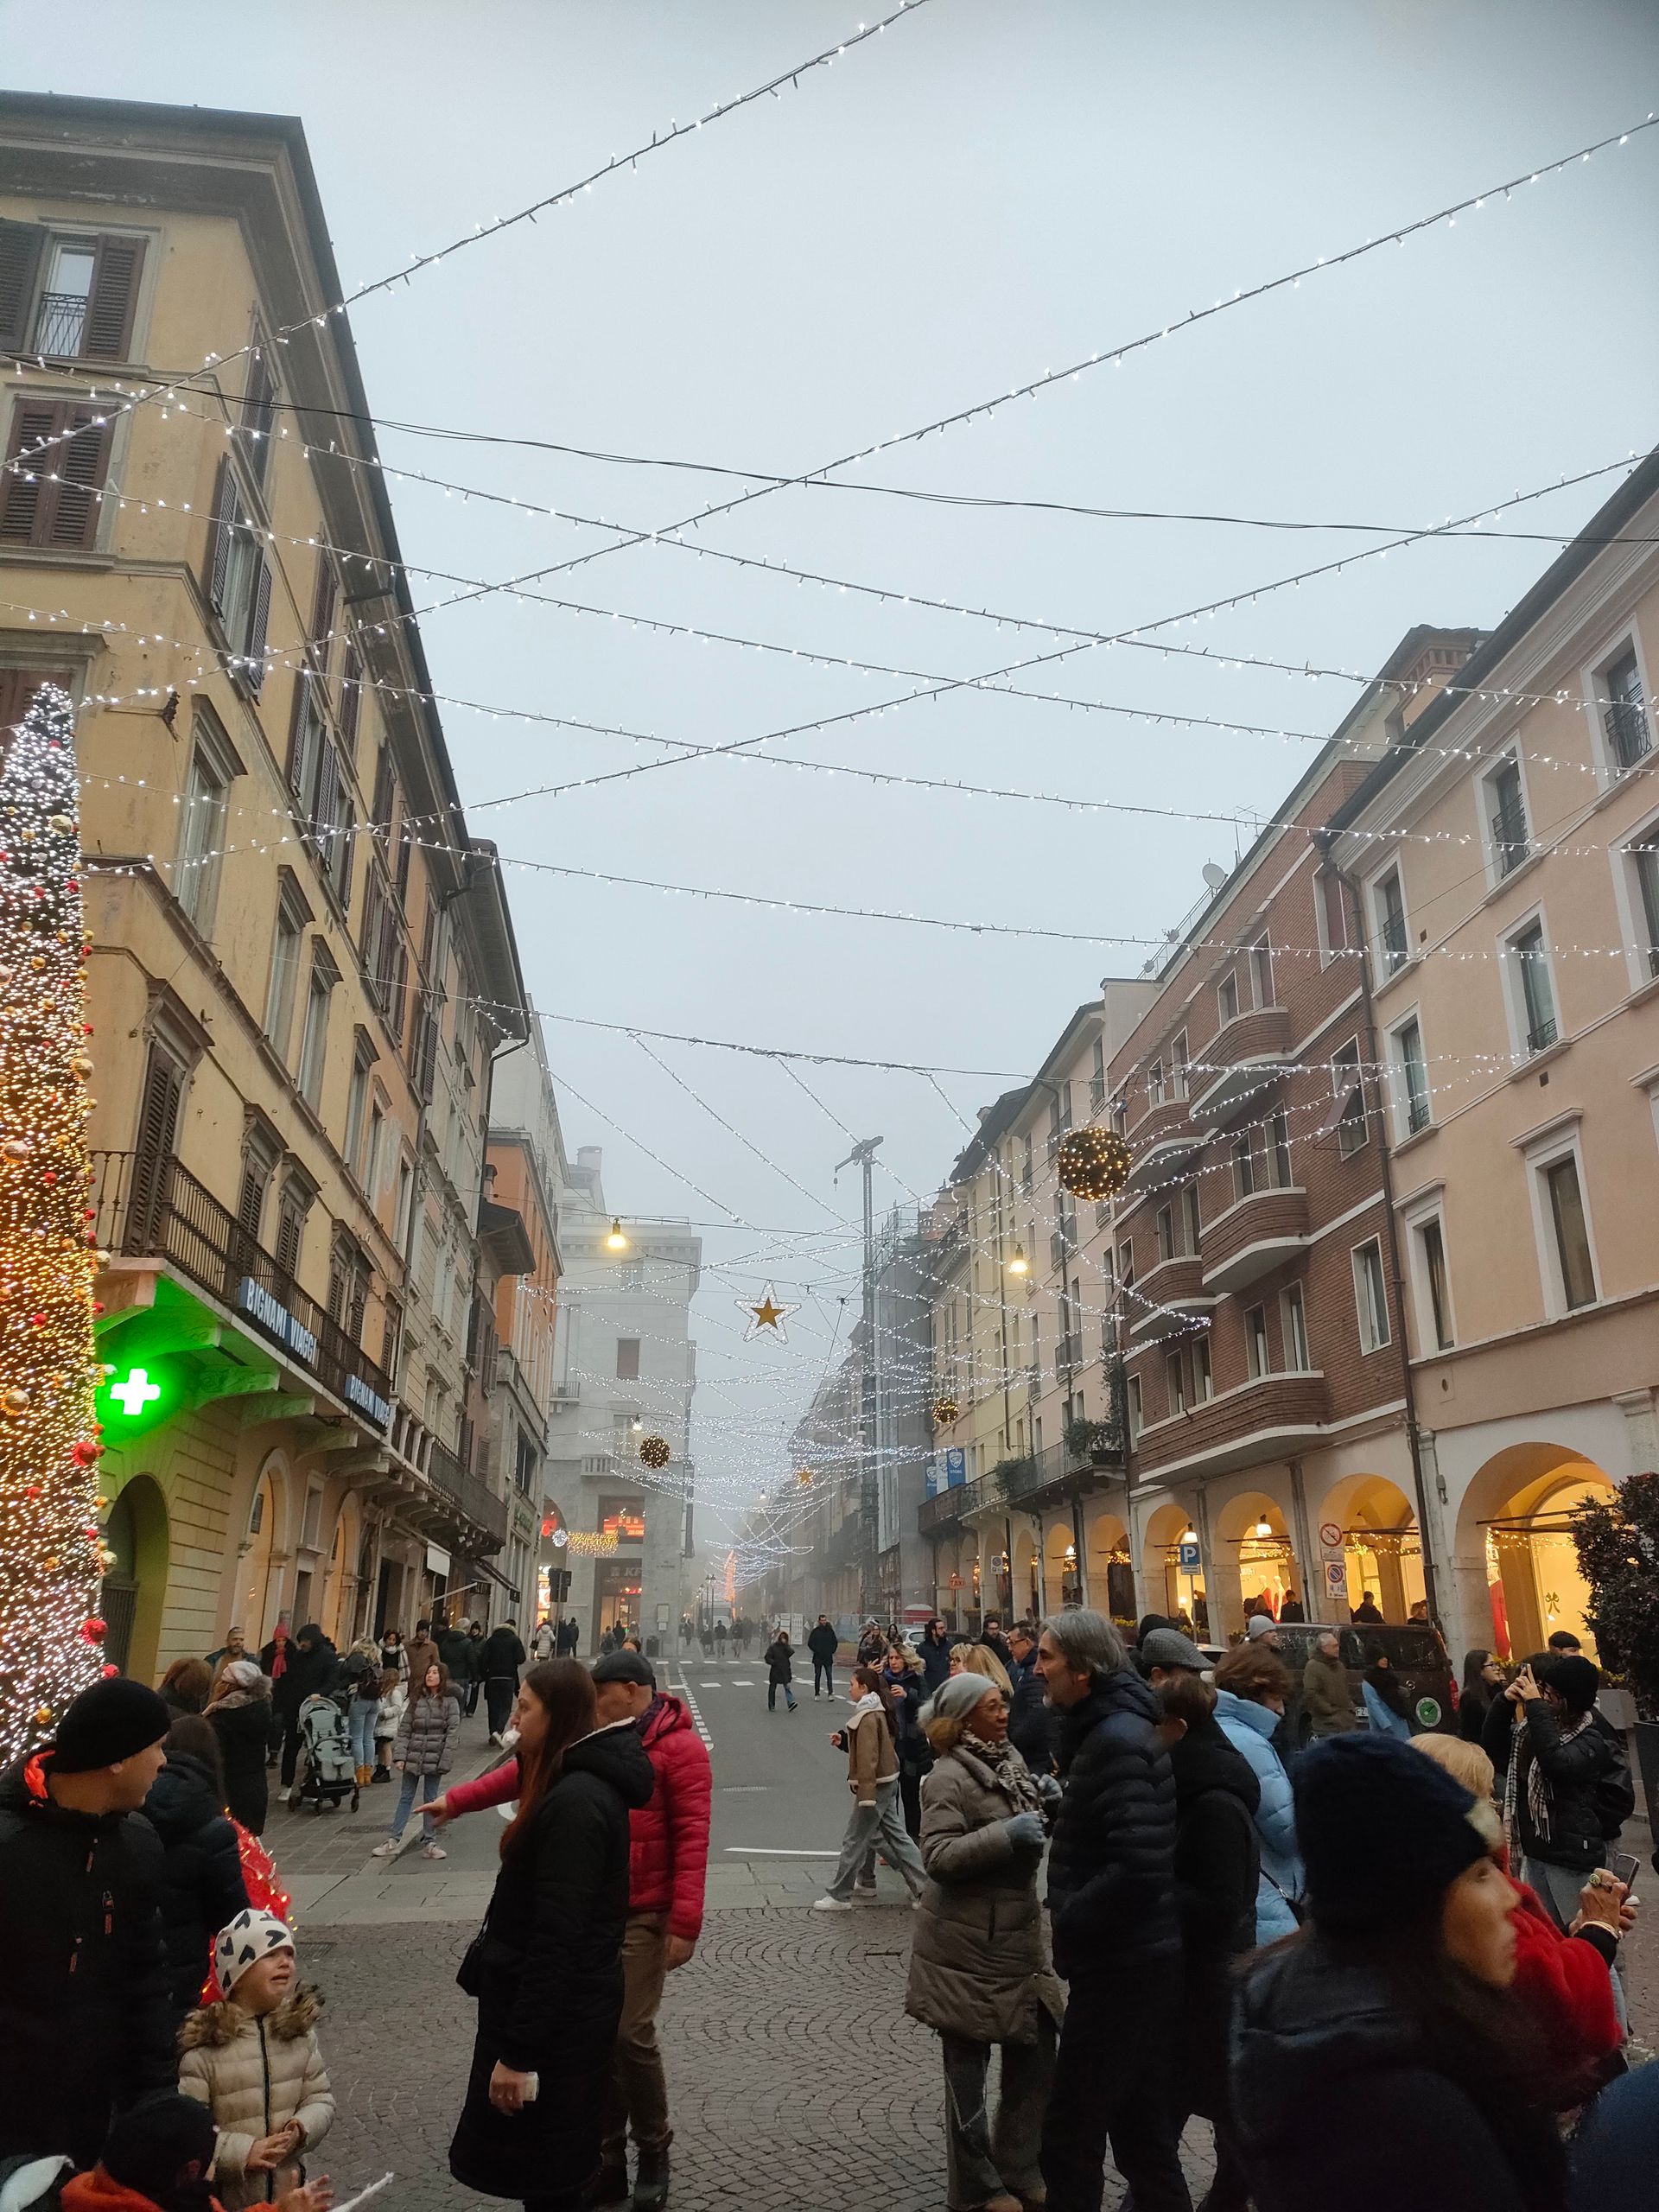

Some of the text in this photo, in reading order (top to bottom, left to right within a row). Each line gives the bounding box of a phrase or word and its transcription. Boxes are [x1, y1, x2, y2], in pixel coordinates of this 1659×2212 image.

[246, 1276, 318, 1365] BIGNAMI VIAGGI
[350, 1374, 390, 1427] BIGNAMI VIAGG
[623, 1567, 642, 1577] KF
[1183, 1546, 1197, 1563] P
